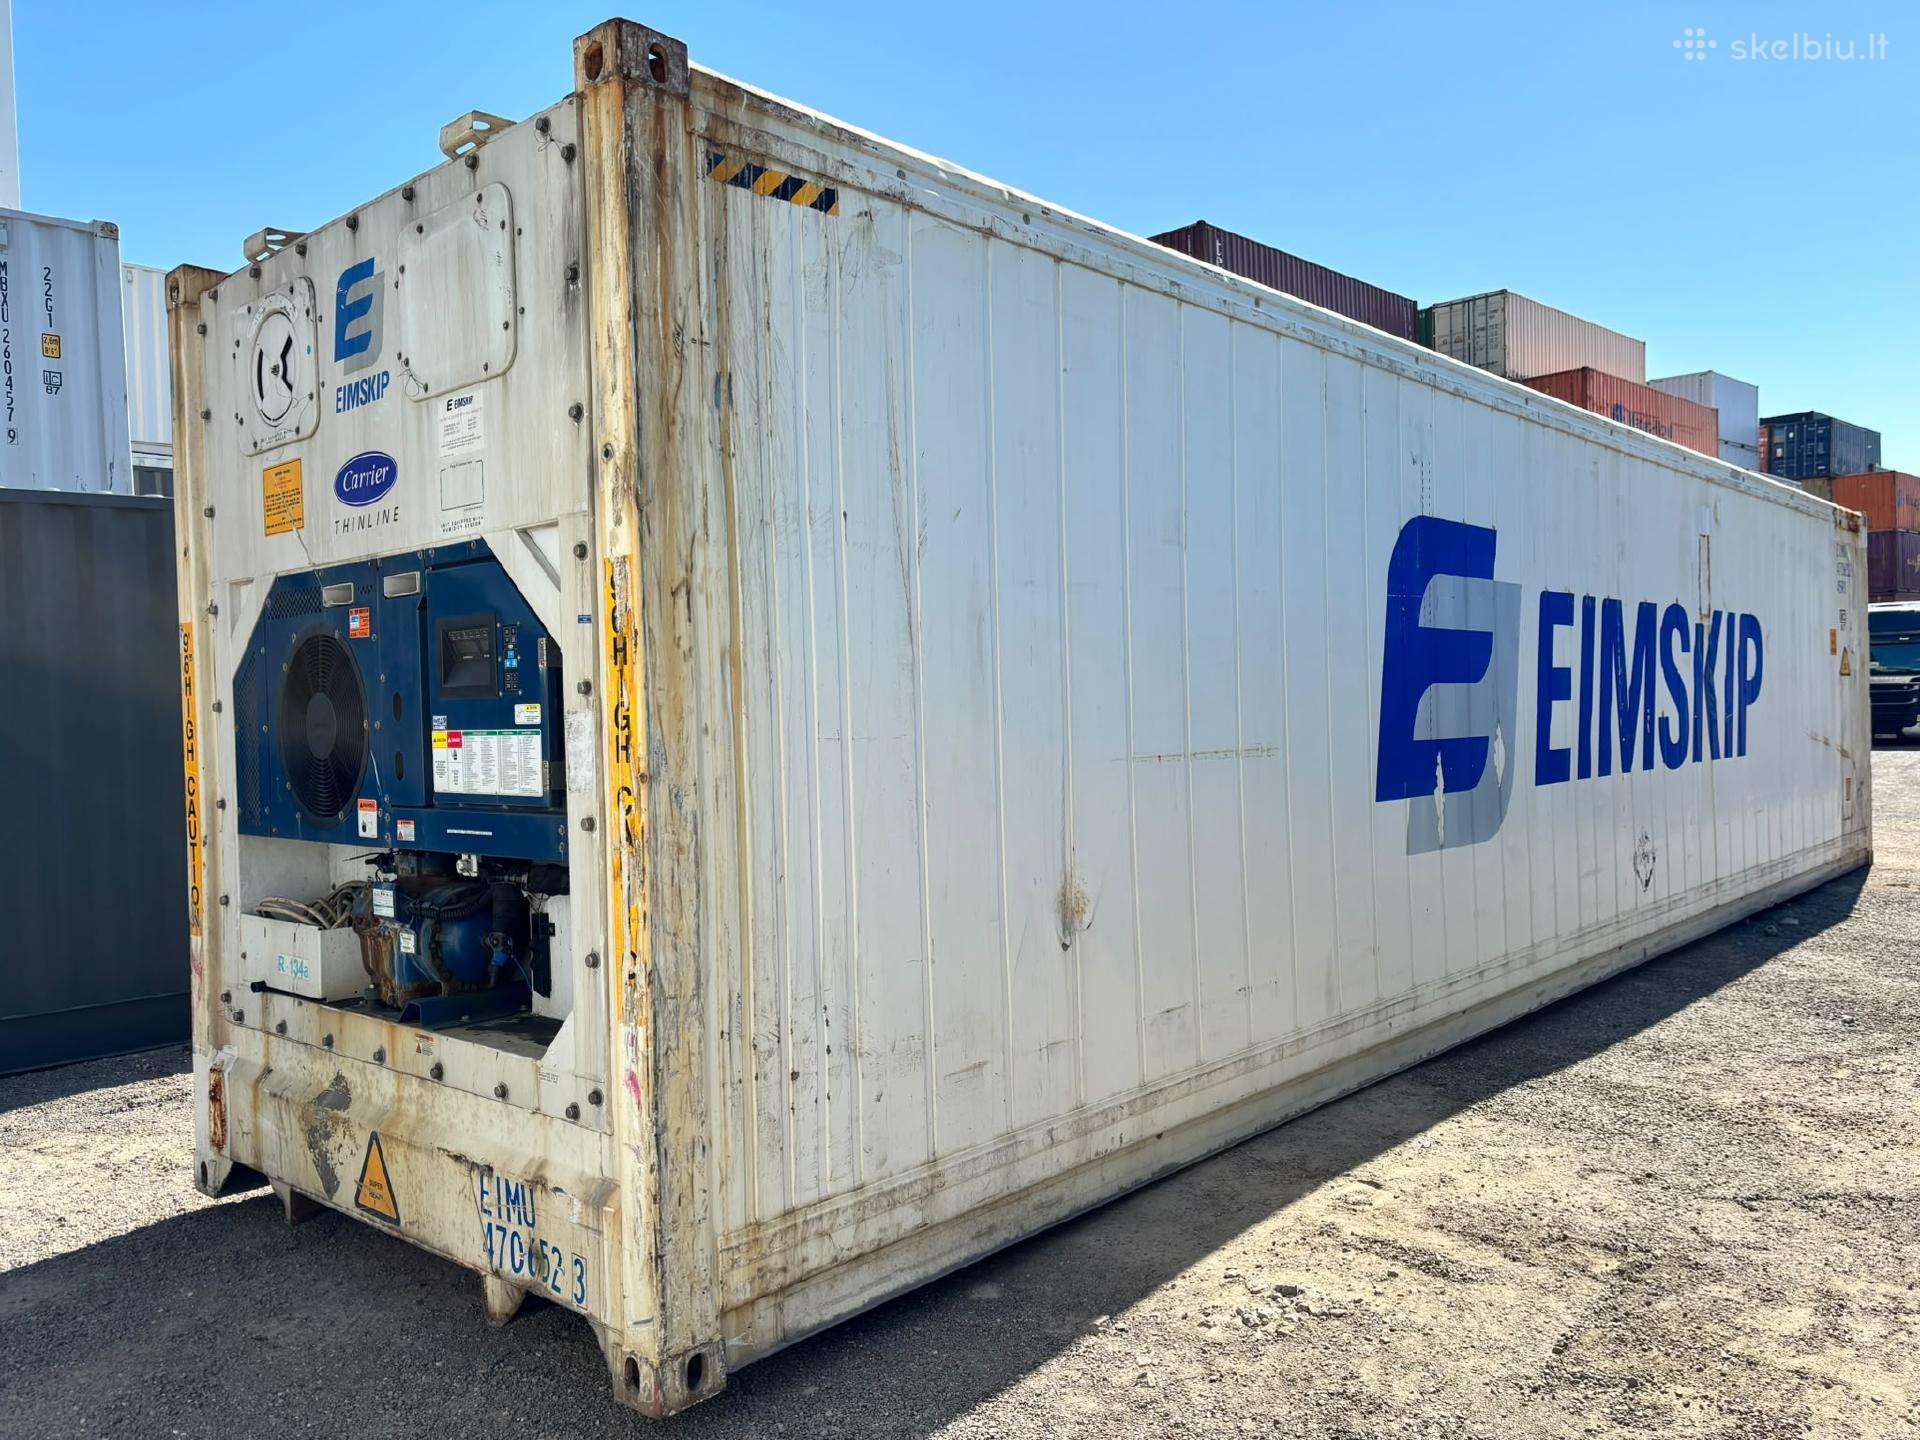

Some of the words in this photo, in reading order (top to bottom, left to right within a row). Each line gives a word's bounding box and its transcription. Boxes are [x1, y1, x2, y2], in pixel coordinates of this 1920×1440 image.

[43, 266, 52, 328] 22G1
[3, 328, 14, 422] 260457
[335, 370, 390, 414] EIMSKIP
[342, 464, 389, 493] Carrier
[334, 506, 399, 536] THINLINE
[1535, 590, 1763, 787] EIMSKIP
[184, 676, 195, 762] HIGH
[480, 1174, 536, 1229] EIMU
[573, 1257, 586, 1305] 3
